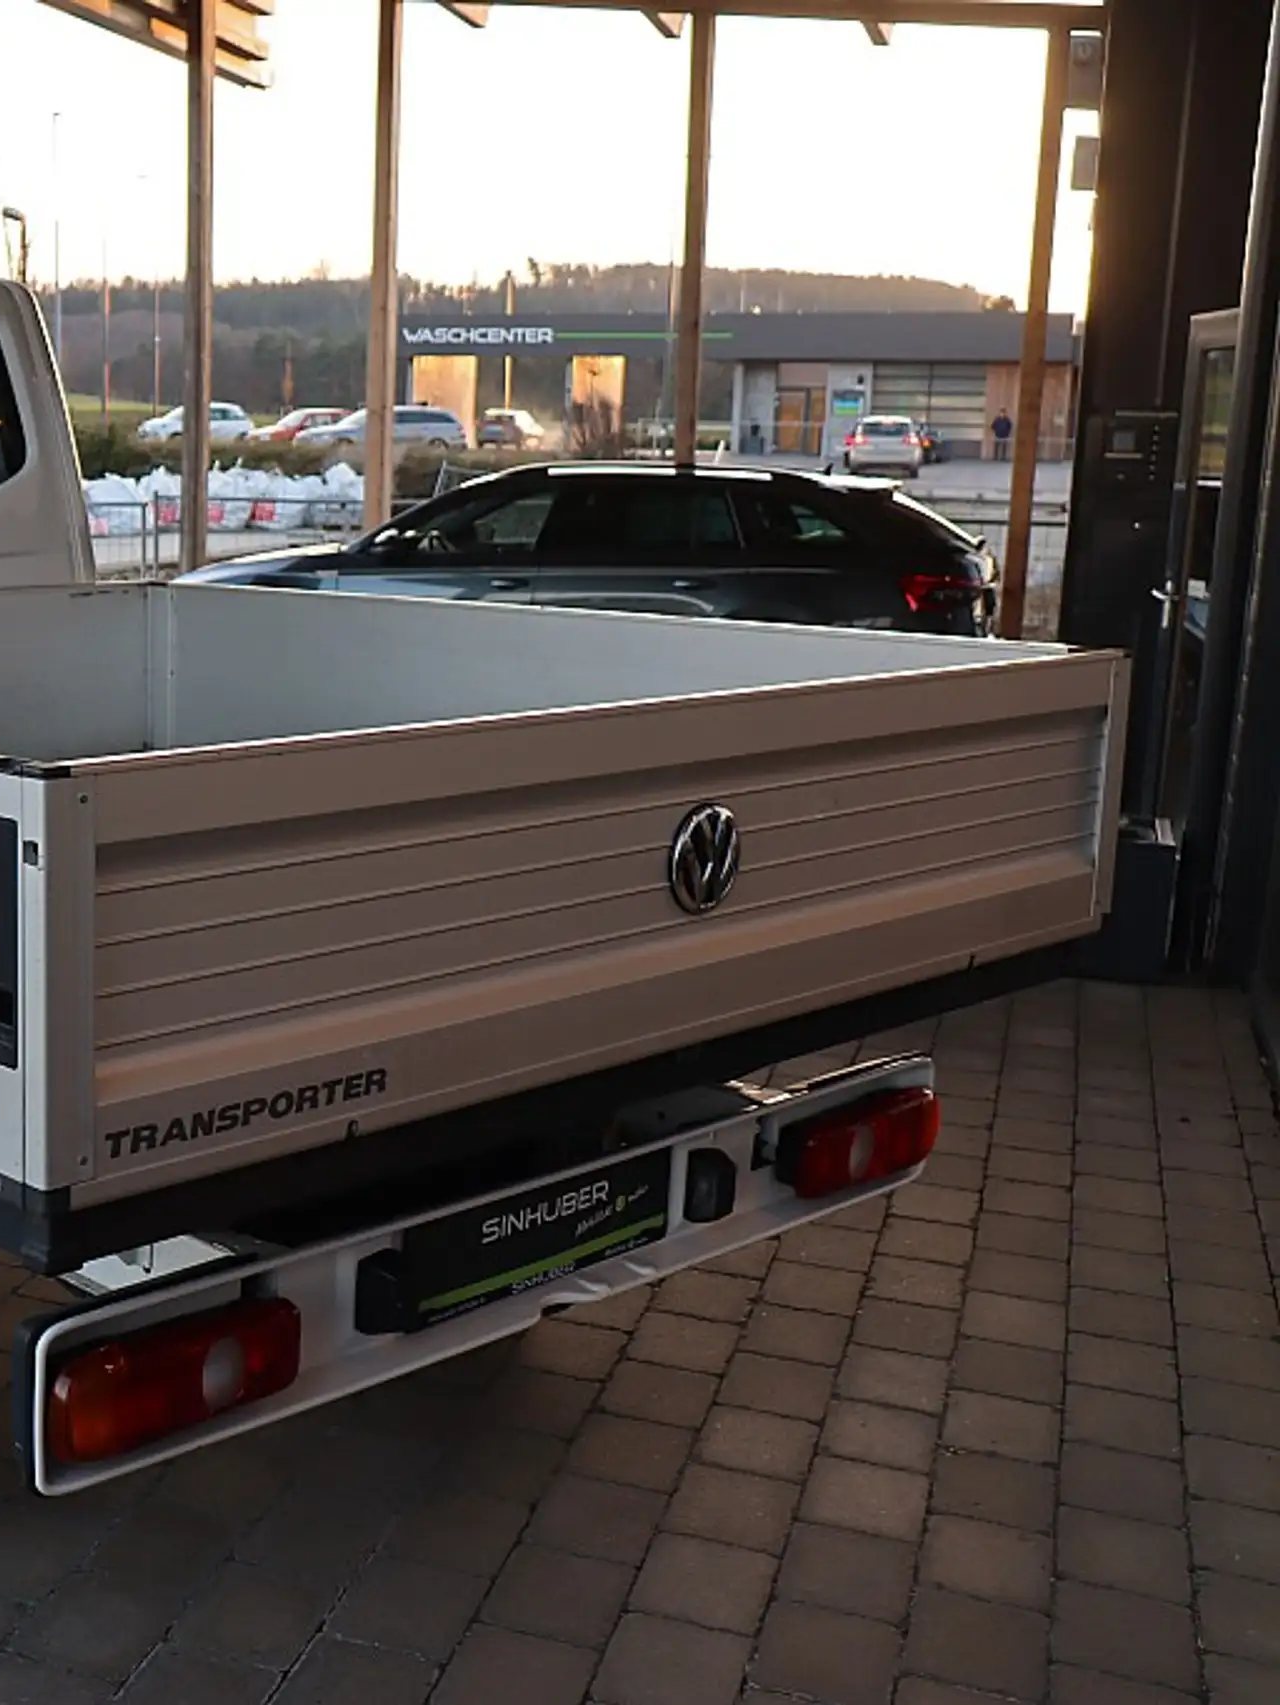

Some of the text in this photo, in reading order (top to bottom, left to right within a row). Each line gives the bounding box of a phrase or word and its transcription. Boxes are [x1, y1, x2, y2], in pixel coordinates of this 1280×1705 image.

[402, 327, 554, 344] WASCHCENTER
[105, 1068, 388, 1160] TRANSPORTER
[481, 1180, 610, 1245] SINHUBER
